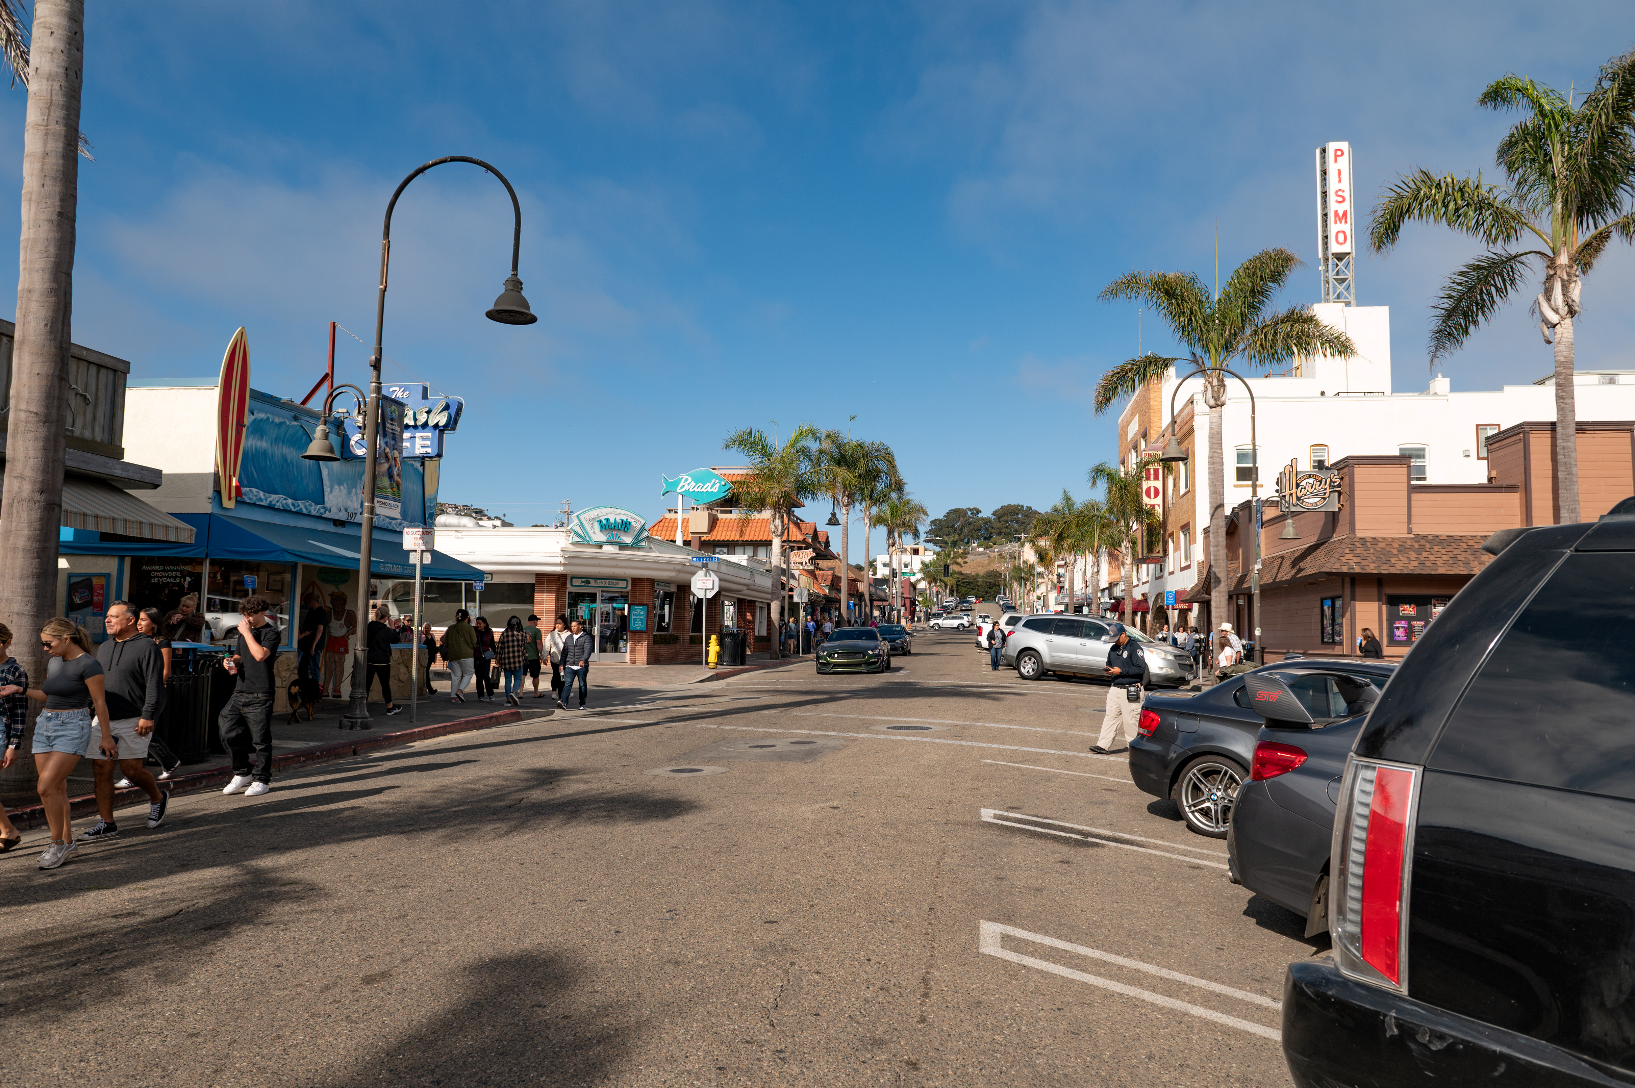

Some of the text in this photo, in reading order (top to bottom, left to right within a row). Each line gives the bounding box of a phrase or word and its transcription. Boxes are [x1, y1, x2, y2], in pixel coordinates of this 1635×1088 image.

[1333, 148, 1348, 246] PISMO
[389, 386, 410, 399] The
[353, 400, 450, 427] Sash
[349, 432, 432, 456] CFE
[676, 475, 720, 493] Brad's
[1279, 457, 1341, 506] Harry's
[346, 511, 357, 522] 197
[596, 517, 632, 533] BRAD'S
